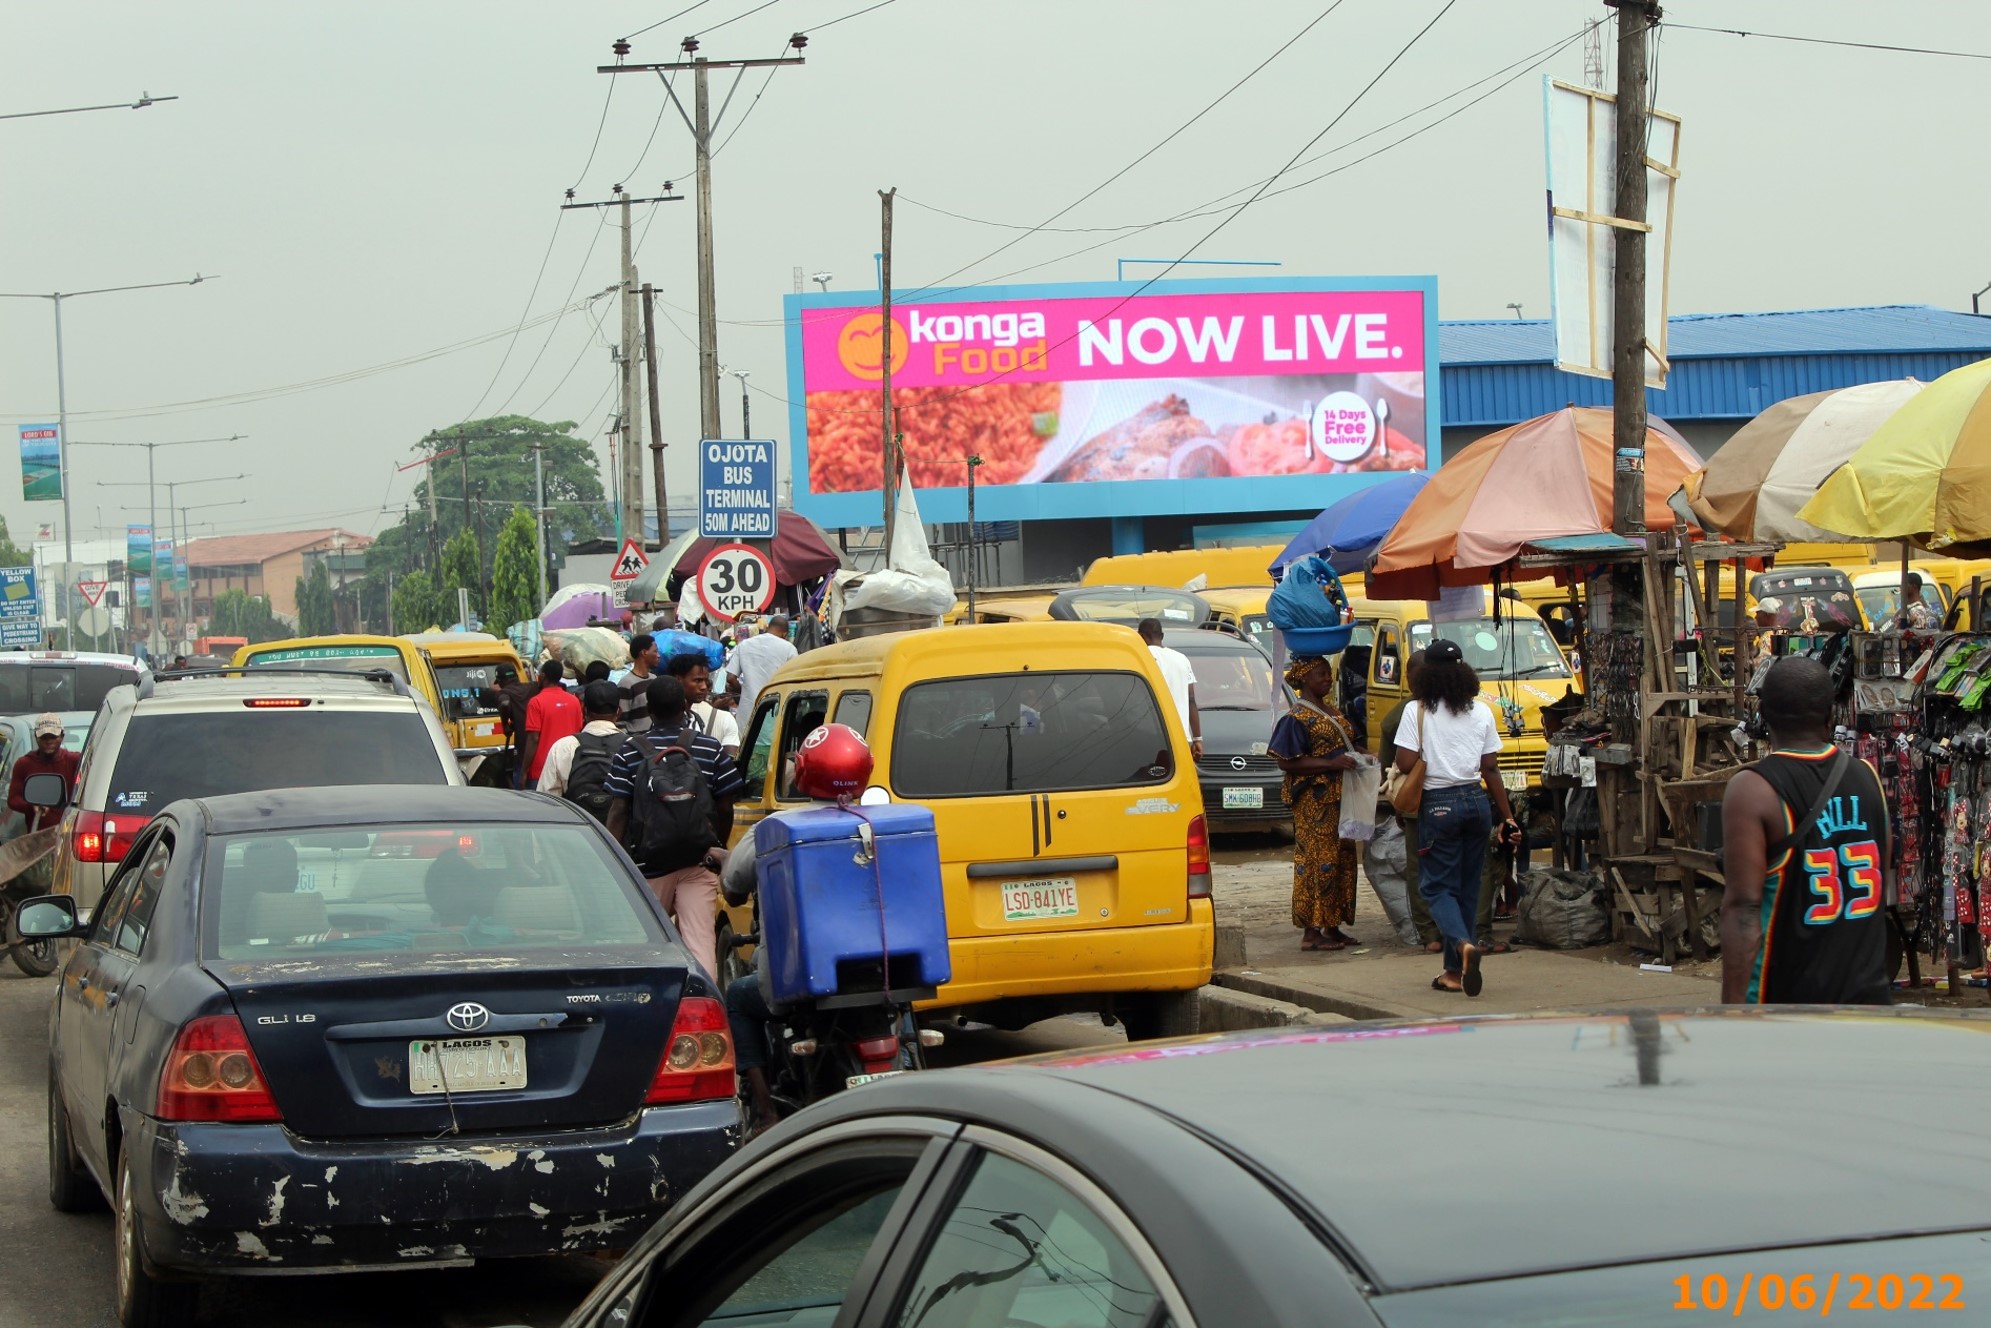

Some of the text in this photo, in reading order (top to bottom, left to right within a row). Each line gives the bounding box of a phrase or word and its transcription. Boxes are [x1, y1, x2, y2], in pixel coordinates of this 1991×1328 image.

[909, 310, 1046, 347] konga
[1078, 313, 1403, 366] NOW LIVE.
[933, 338, 1047, 376] Food
[1324, 409, 1367, 422] 14 Days
[1324, 420, 1366, 435] Free
[1325, 435, 1367, 446] Delivery
[708, 444, 768, 463] OJOTA
[723, 466, 753, 485] BUS
[706, 489, 771, 508] TERMINAL
[705, 513, 770, 532] 50M AHEAD
[0, 568, 31, 576] YELLOW
[7, 575, 25, 583] BOX
[709, 558, 762, 594] 30
[718, 595, 755, 611] KPH
[4, 636, 37, 644] CROSSING
[1803, 839, 1883, 925] 33
[566, 994, 601, 1003] TOYOTA
[442, 1039, 492, 1049] LAGOS
